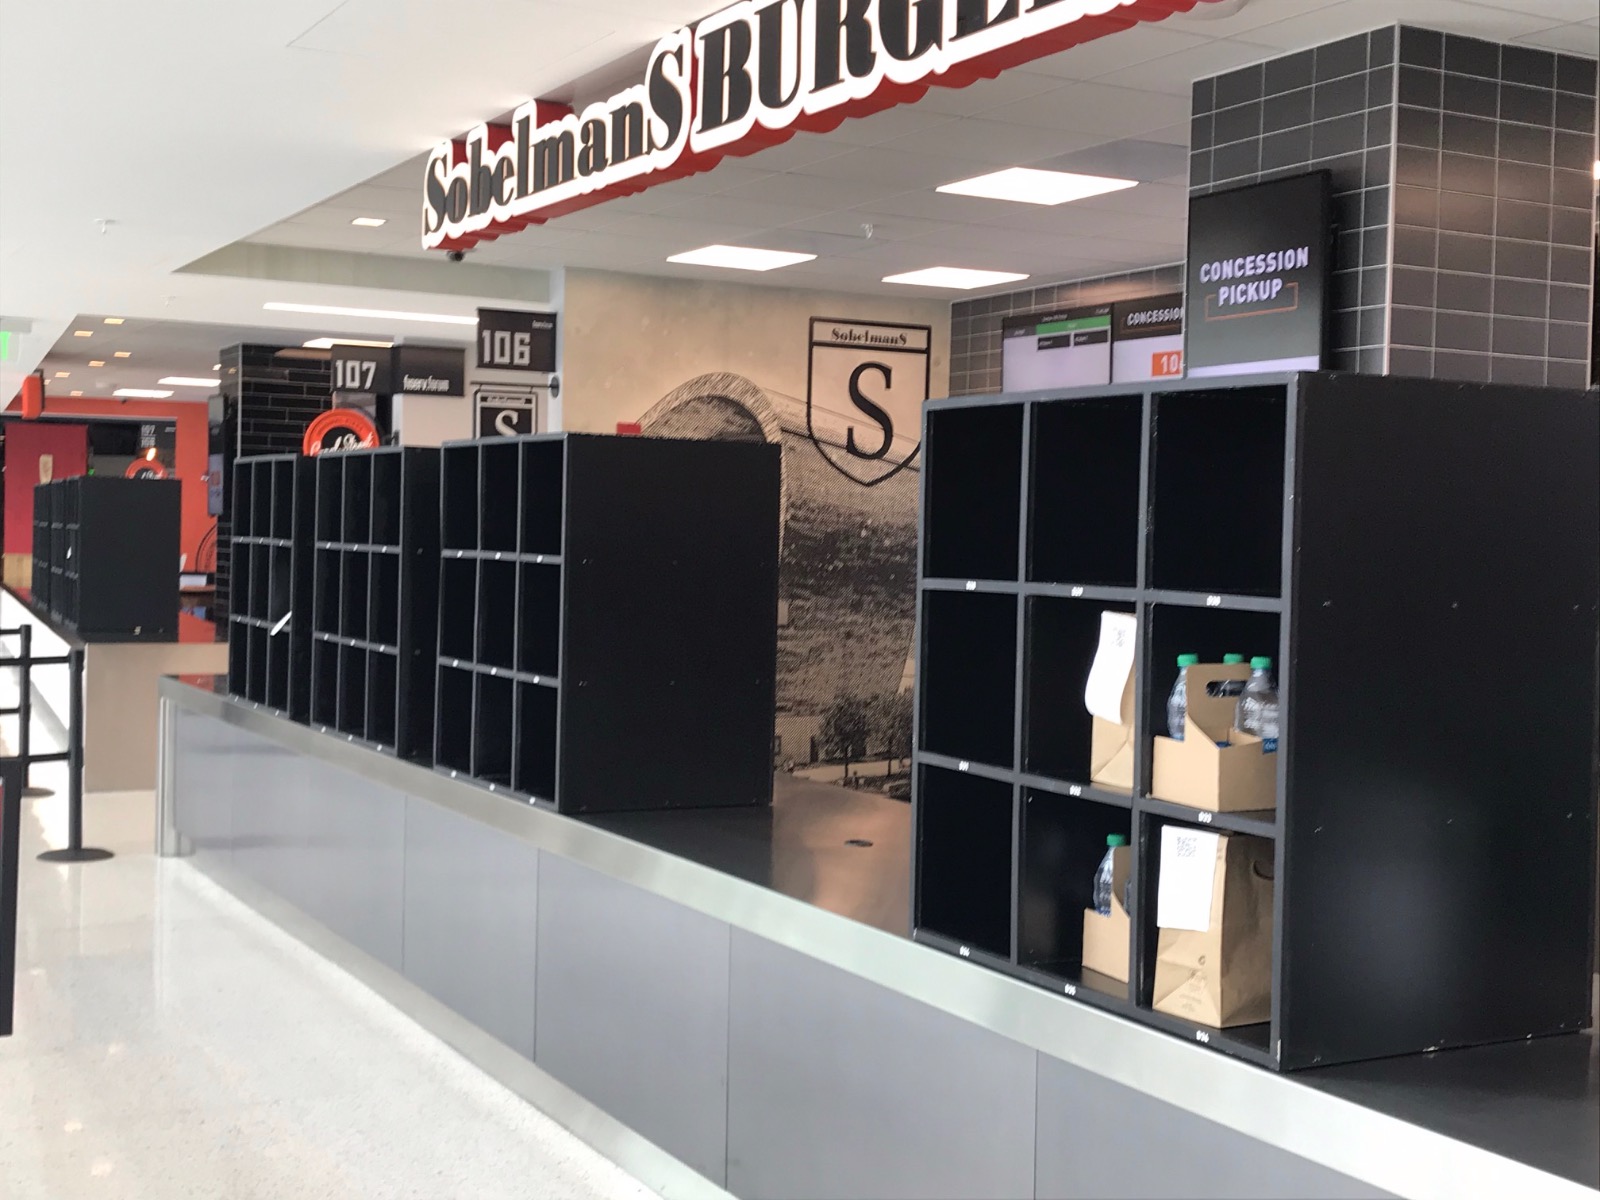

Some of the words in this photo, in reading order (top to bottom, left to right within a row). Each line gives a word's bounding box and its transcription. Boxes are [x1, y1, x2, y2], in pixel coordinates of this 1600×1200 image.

[424, 43, 684, 236] SobelmanS
[1199, 245, 1309, 283] CONCESSION
[1217, 277, 1284, 307] PICKUP
[481, 329, 531, 366] 106
[831, 326, 908, 346] SobelmanS
[335, 359, 377, 390] 107
[1160, 352, 1184, 376] 10
[847, 361, 893, 458] S
